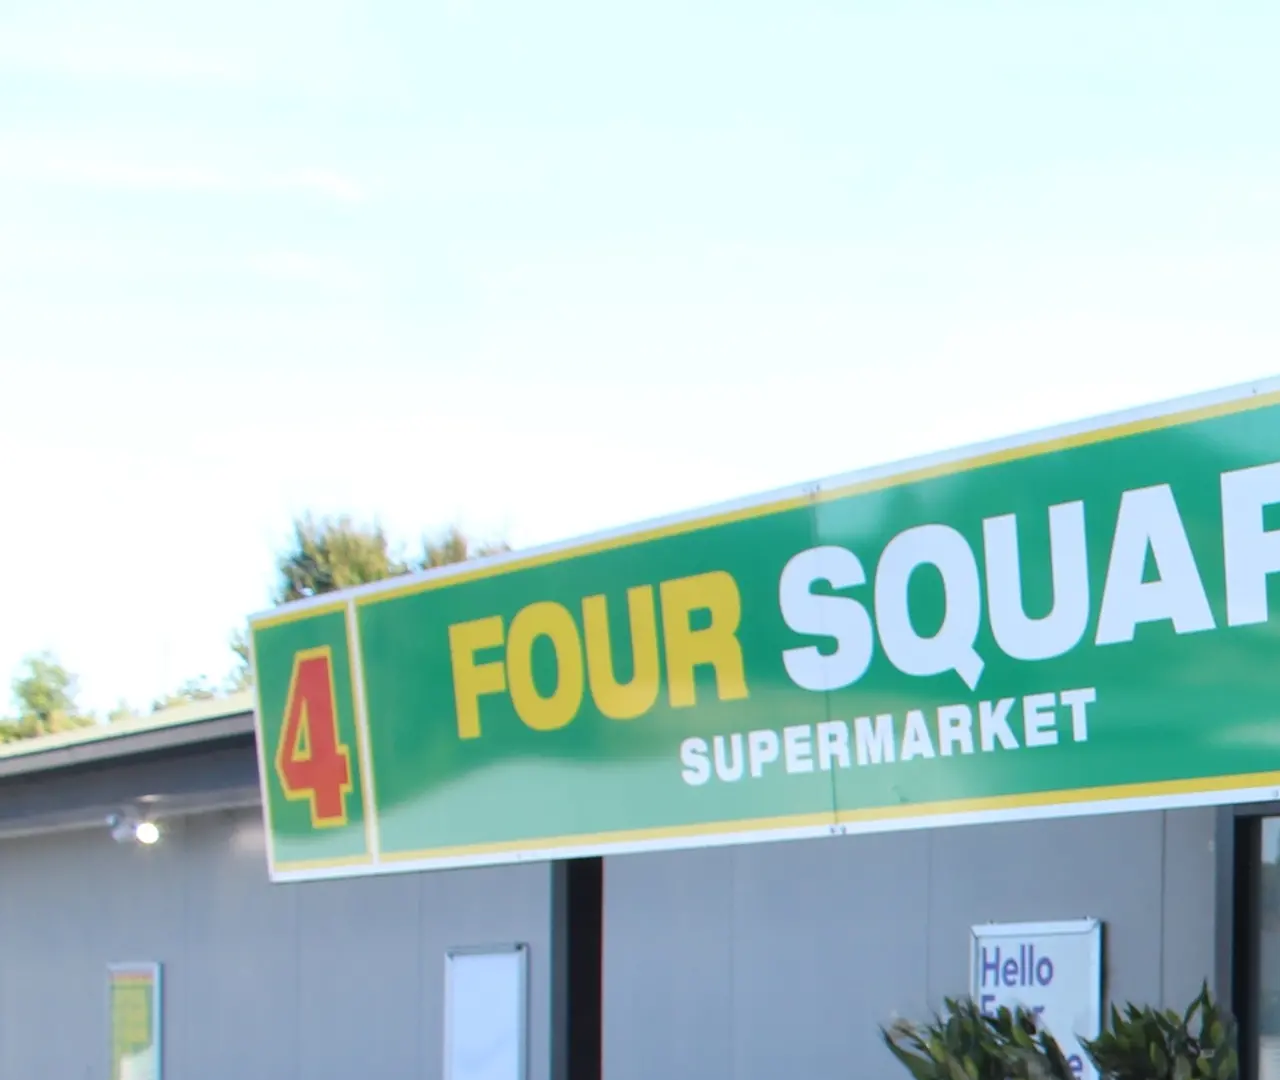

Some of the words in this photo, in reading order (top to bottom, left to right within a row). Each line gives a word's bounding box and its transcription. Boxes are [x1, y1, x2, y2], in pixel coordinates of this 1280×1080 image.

[448, 569, 749, 740] FOUR
[275, 646, 352, 829] 4
[680, 687, 1096, 786] SUPERMARKET
[981, 944, 1054, 987] Hello
